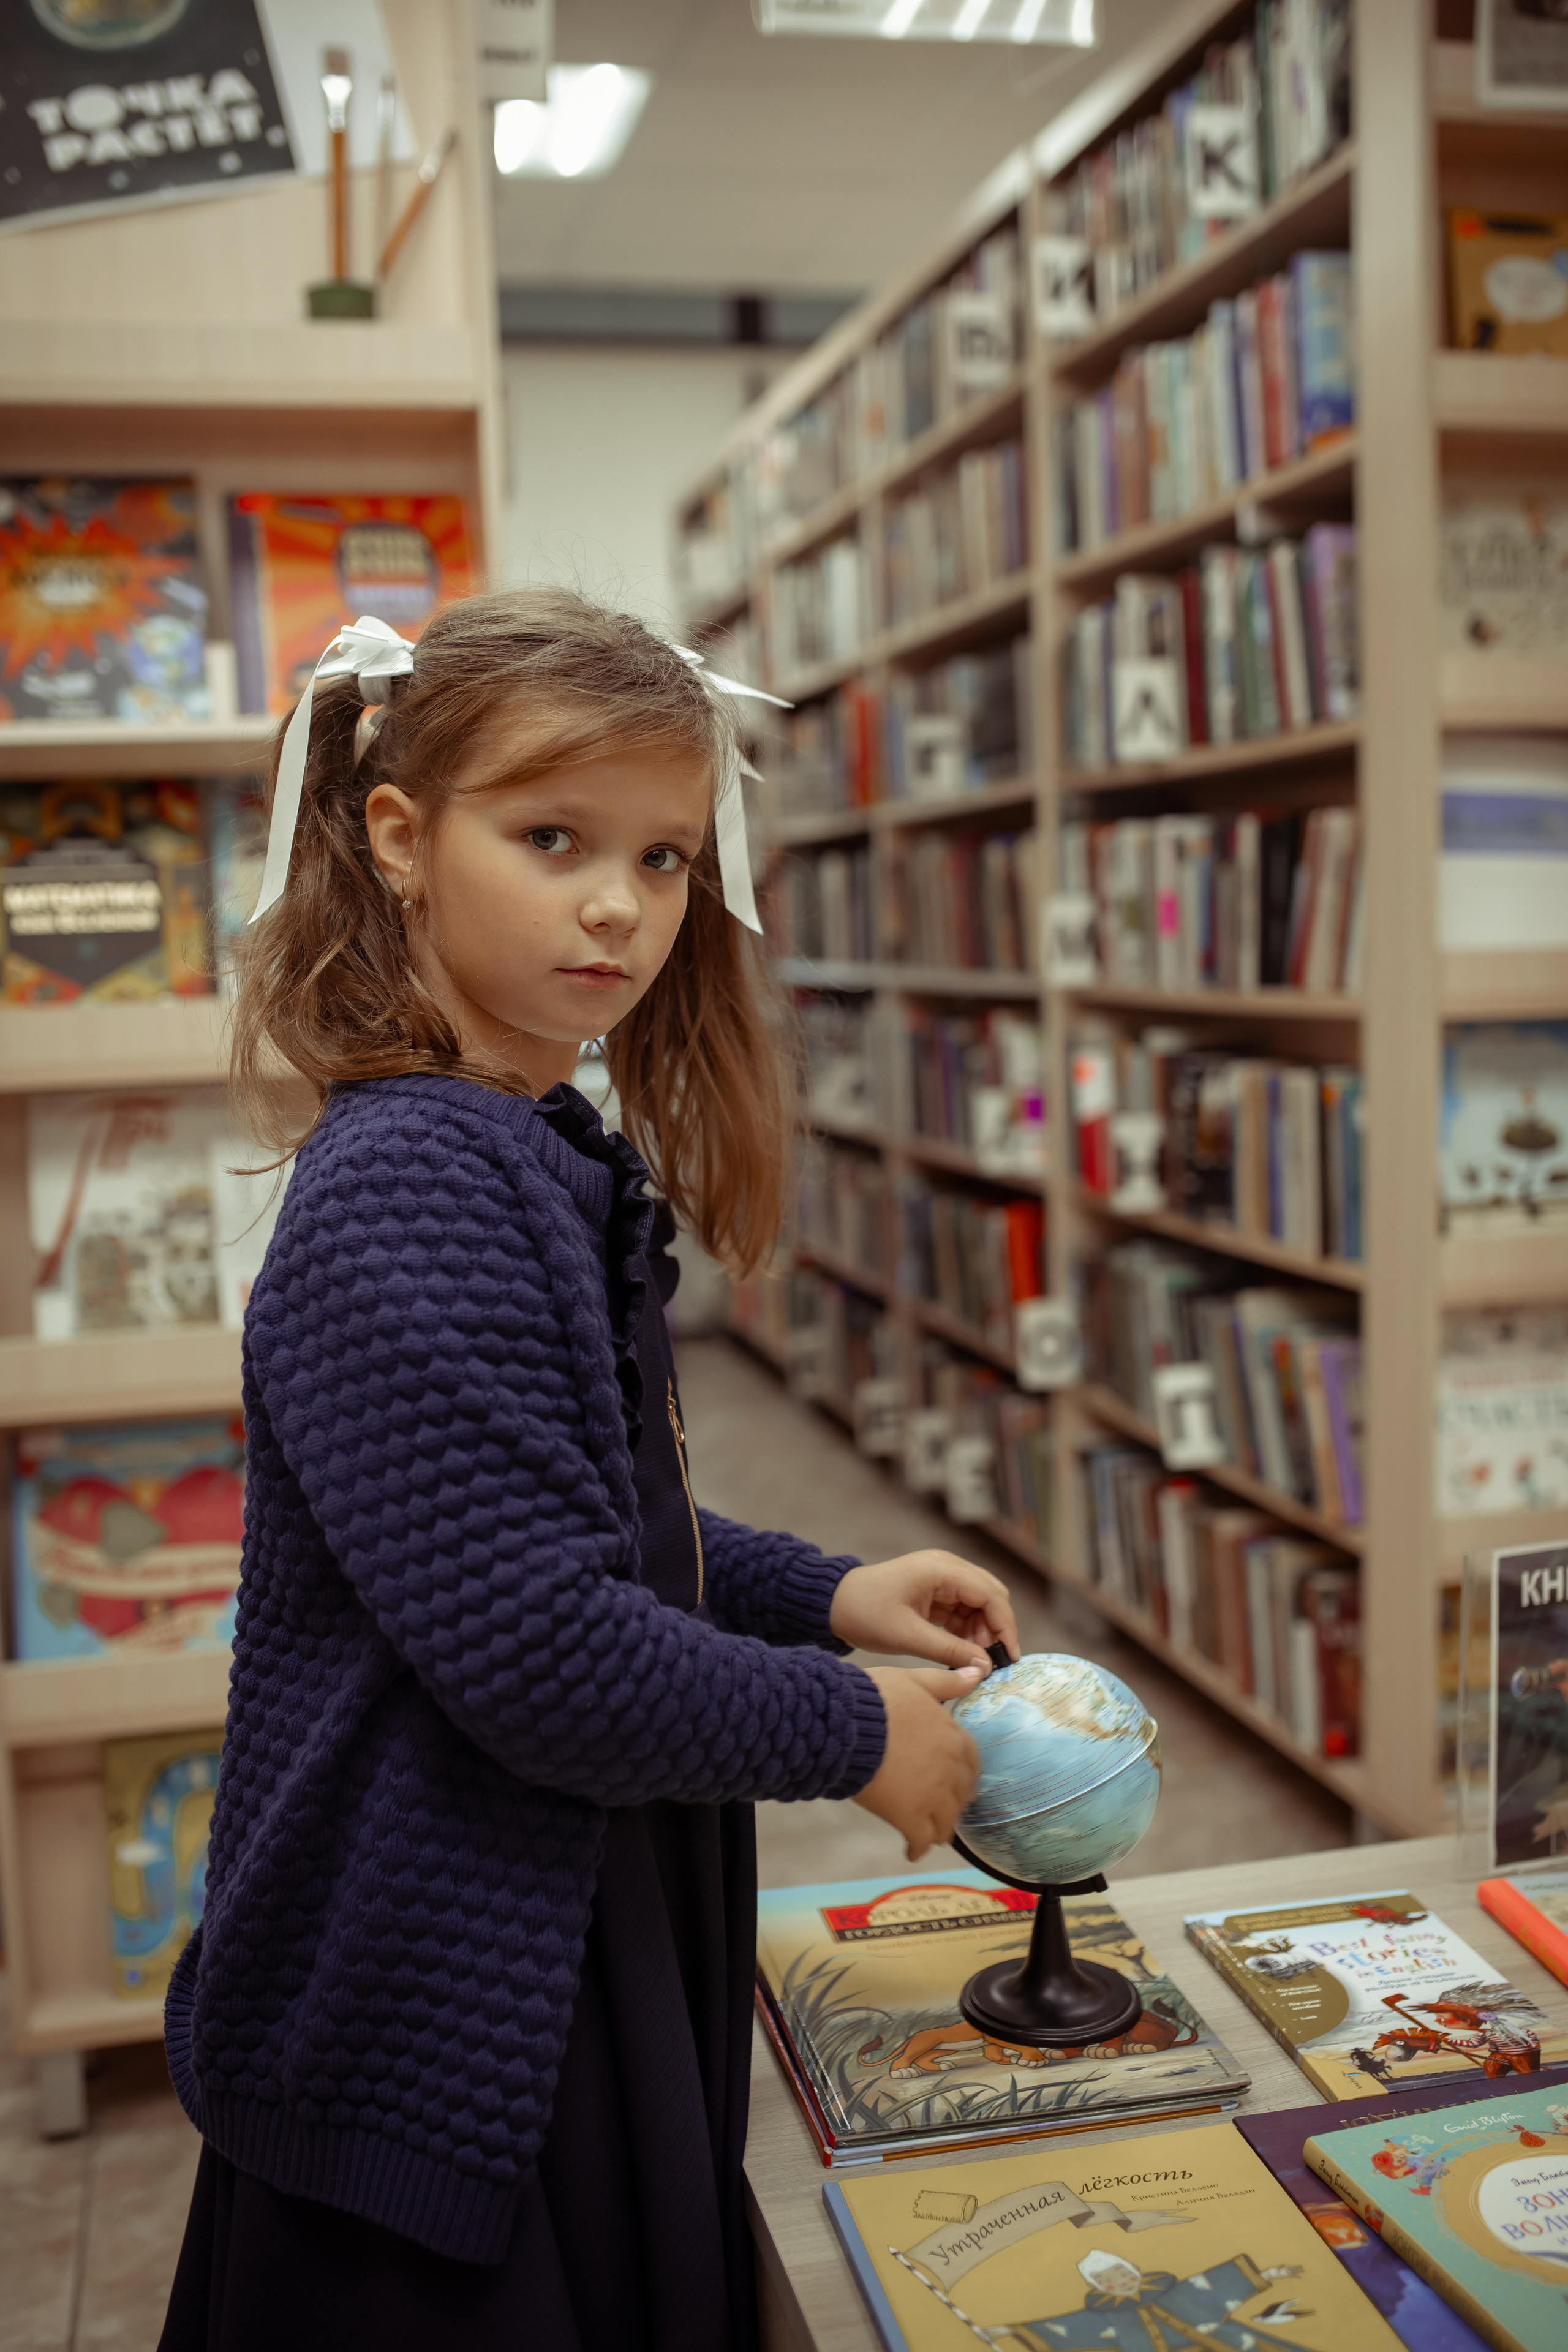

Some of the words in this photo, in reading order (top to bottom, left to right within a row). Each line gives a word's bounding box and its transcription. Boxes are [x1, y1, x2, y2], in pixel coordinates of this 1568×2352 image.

[26, 67, 259, 135] ТОЧКА
[1521, 1565, 1568, 1608] КН
[844, 1918, 957, 1939] ГОРДОСТЬ
[1308, 1937, 1368, 1957] Best
[1383, 1933, 1447, 1946] funny
[1374, 1958, 1458, 1975] English
[1444, 2122, 1479, 2133] Enid
[1478, 2111, 1525, 2127] Blyton
[1131, 2189, 1178, 2202] Кристина
[1180, 2184, 1219, 2193] Беллемо
[1176, 2195, 1215, 2206] Аличия
[1216, 2188, 1256, 2199] Баладан
[1515, 2188, 1568, 2213] ЗОН
[928, 2191, 1065, 2266] Утраченная
[1078, 2169, 1193, 2195] лёгкость
